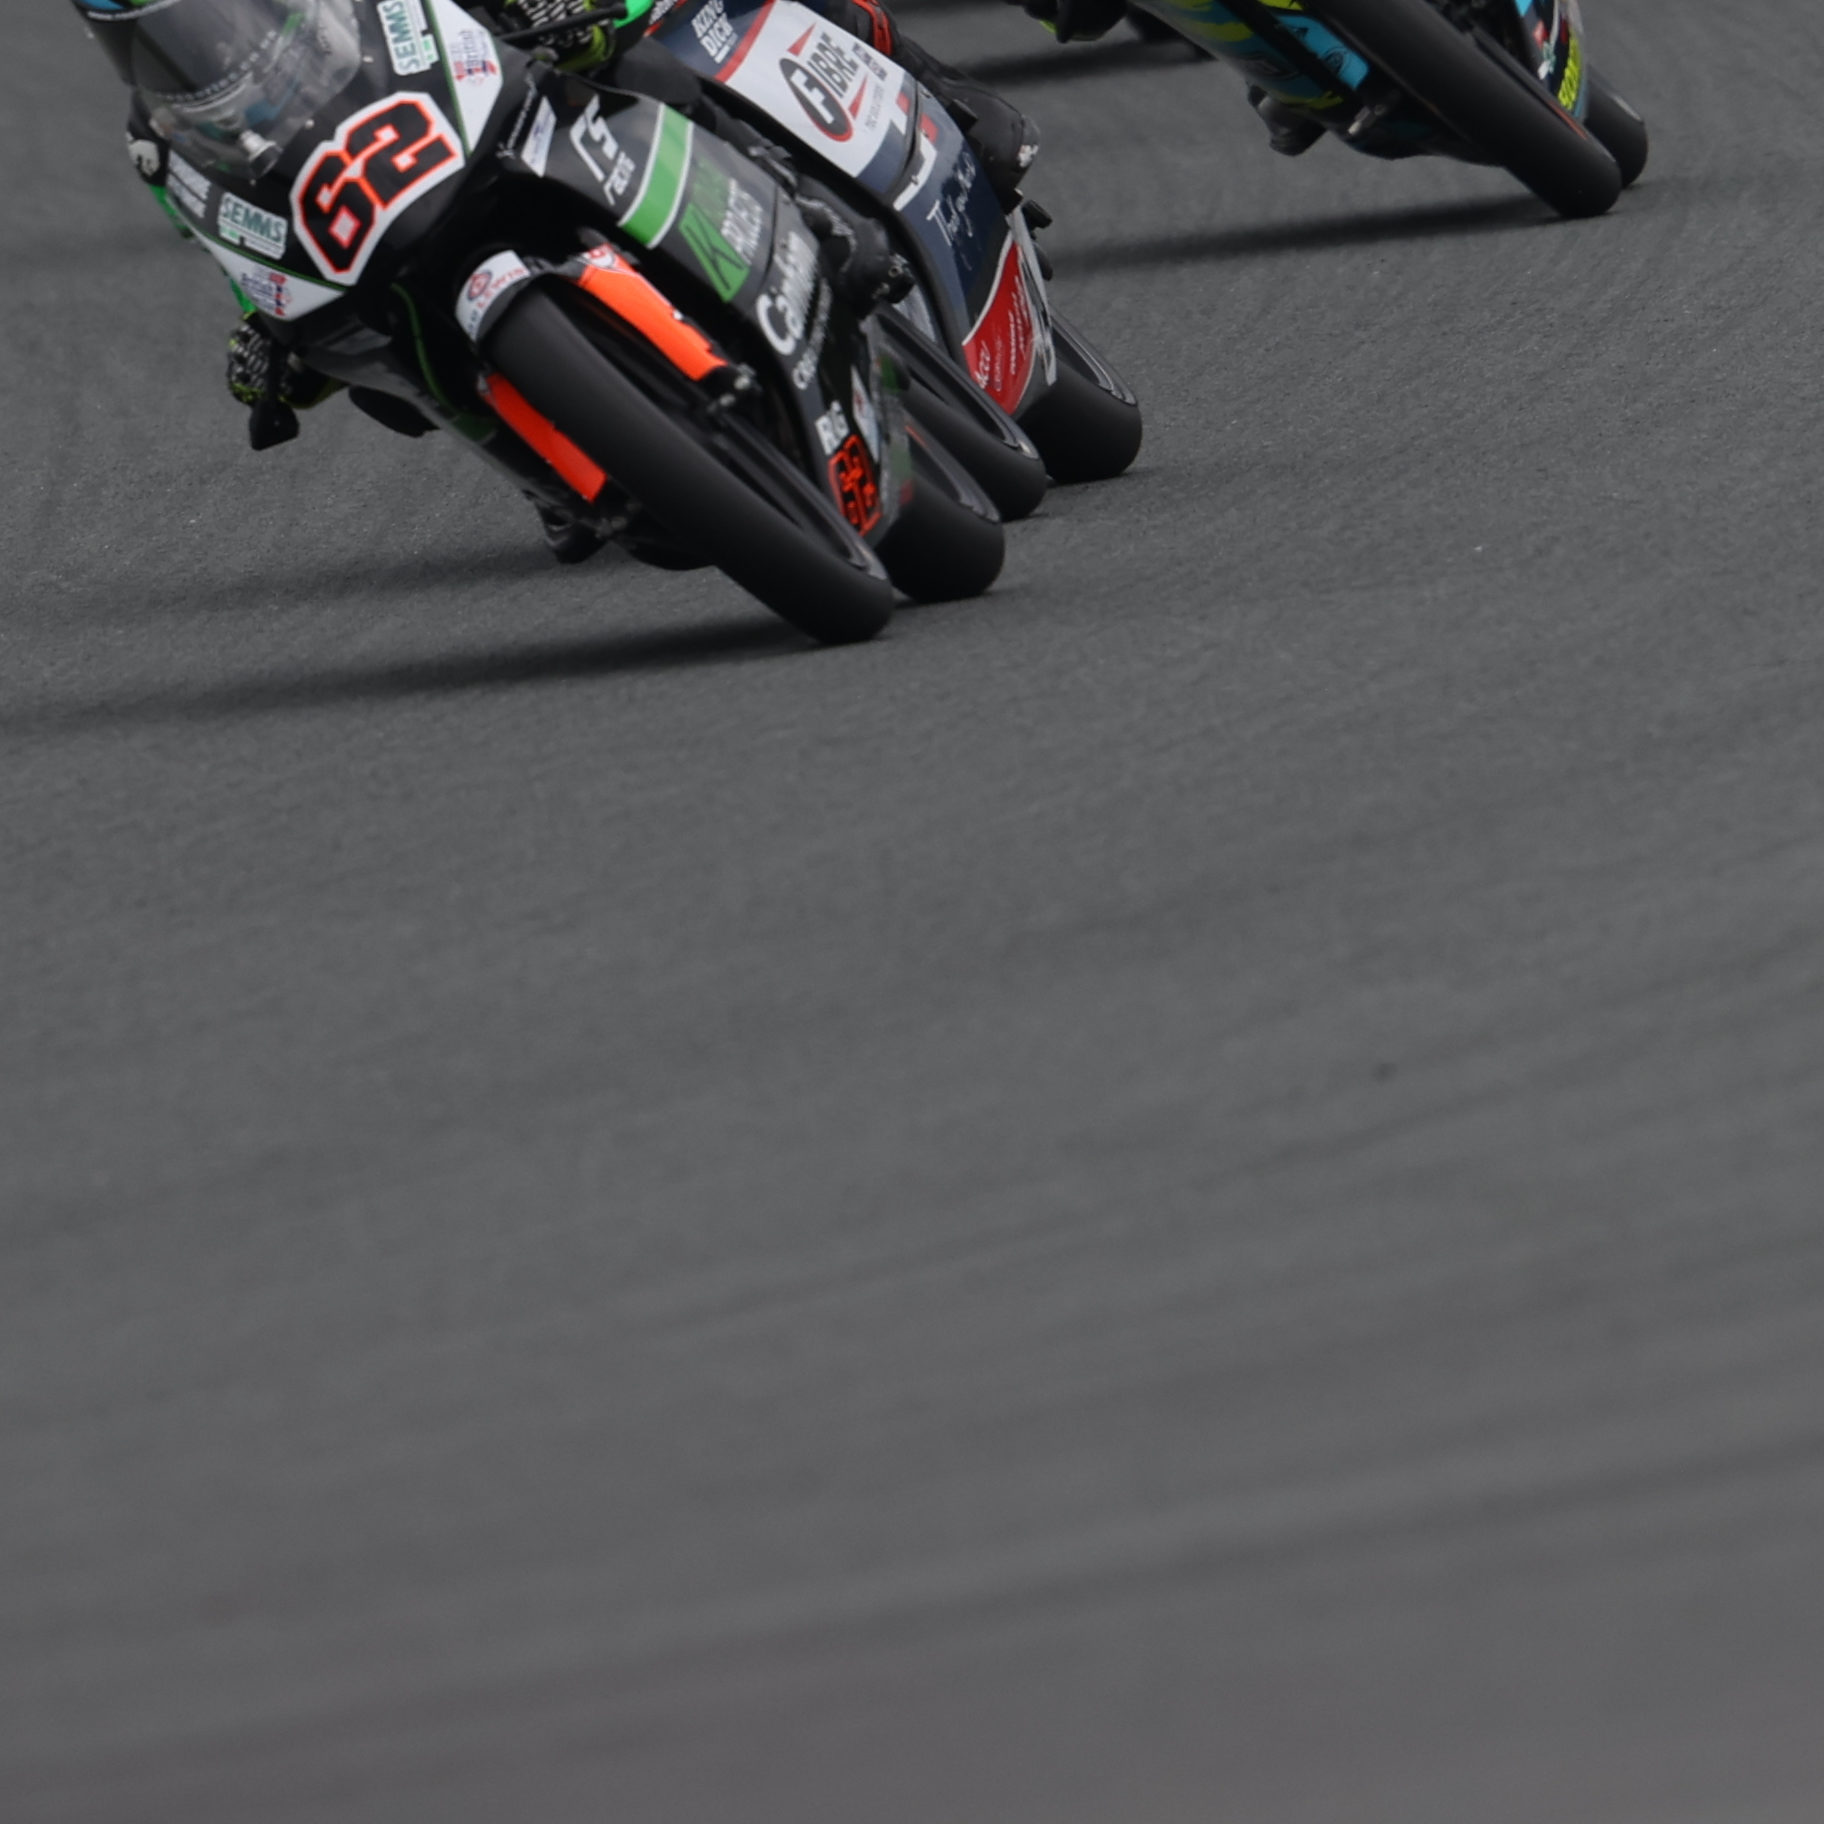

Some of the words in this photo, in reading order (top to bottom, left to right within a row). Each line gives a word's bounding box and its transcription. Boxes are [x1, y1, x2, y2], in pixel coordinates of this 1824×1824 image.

[382, 0, 421, 70] SEMMS
[700, 12, 734, 57] DICK
[297, 98, 458, 274] 62
[221, 197, 284, 243] SEMMS
